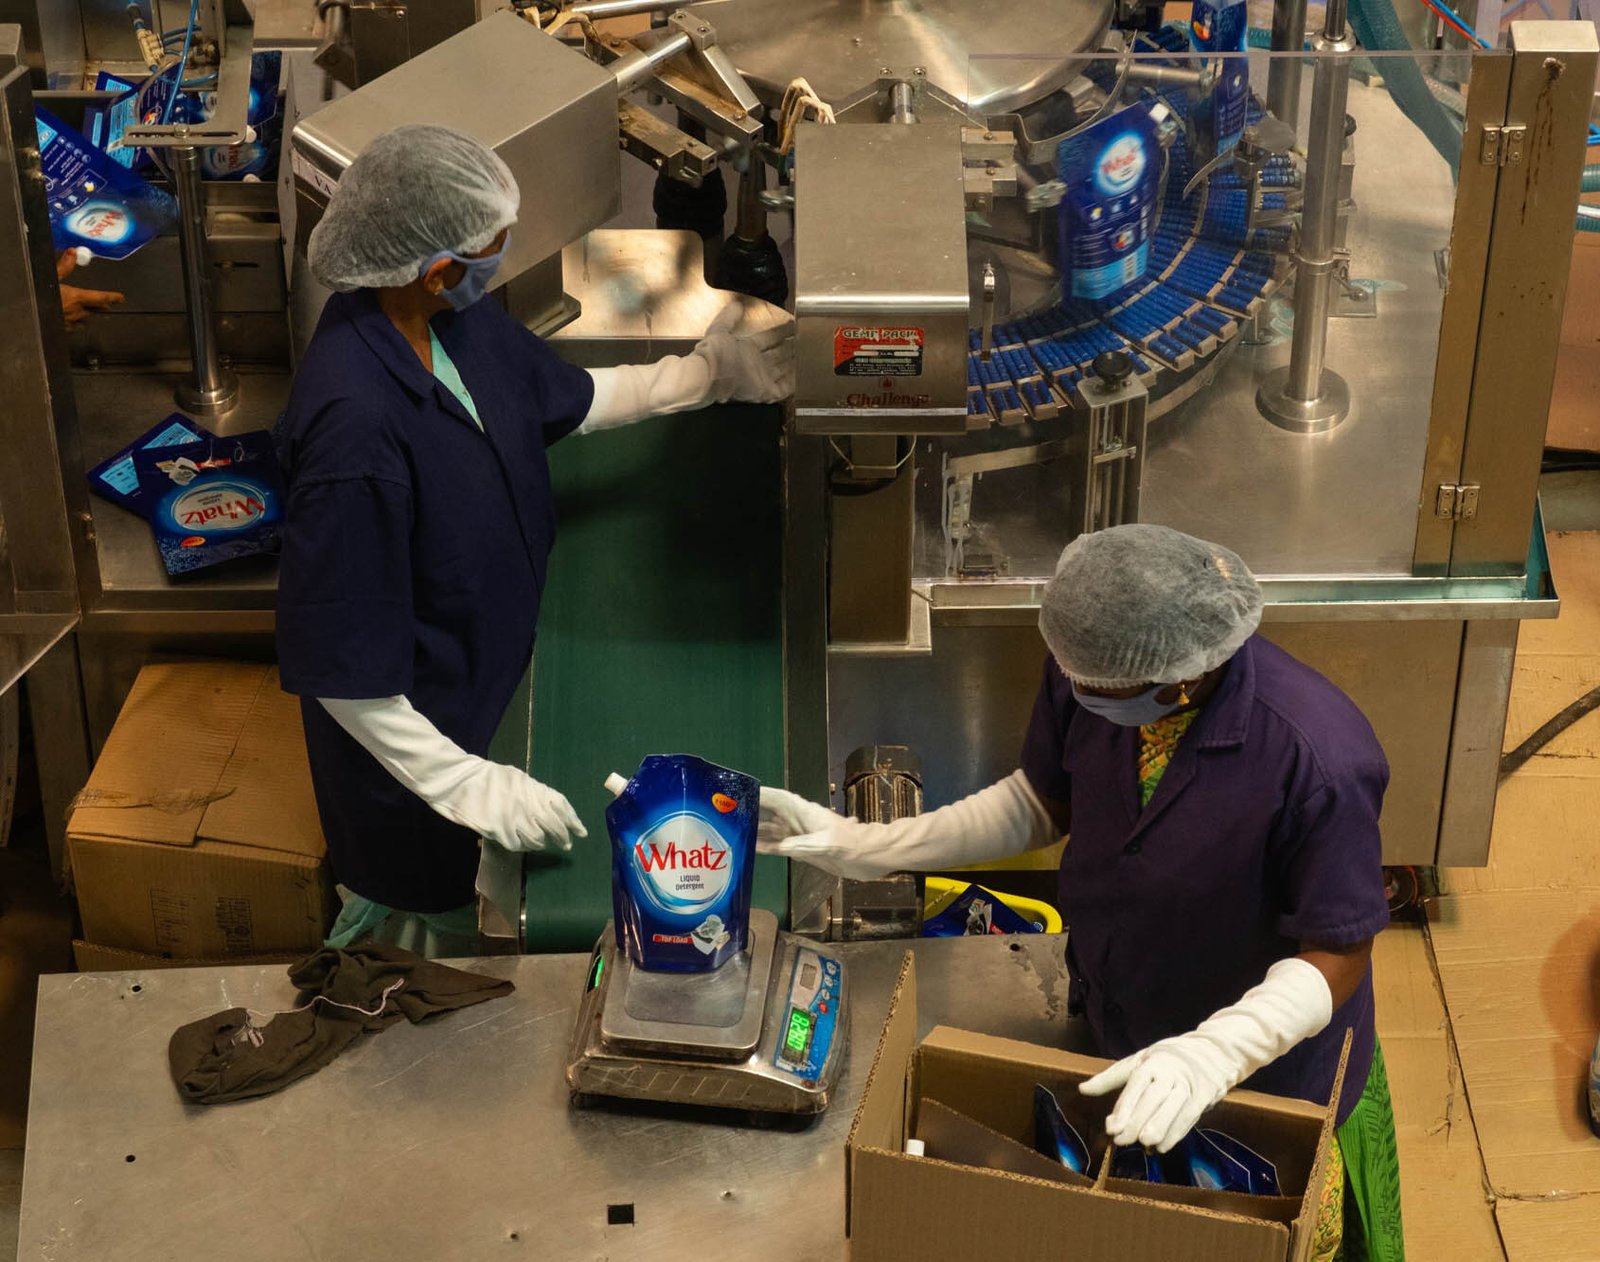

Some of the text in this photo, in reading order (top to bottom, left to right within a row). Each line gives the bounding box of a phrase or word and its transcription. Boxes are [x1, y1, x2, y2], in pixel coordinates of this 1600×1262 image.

[181, 497, 264, 525] Whatz
[635, 838, 728, 873] Whatz
[675, 883, 704, 891] Detergent
[680, 875, 701, 883] LIQUID
